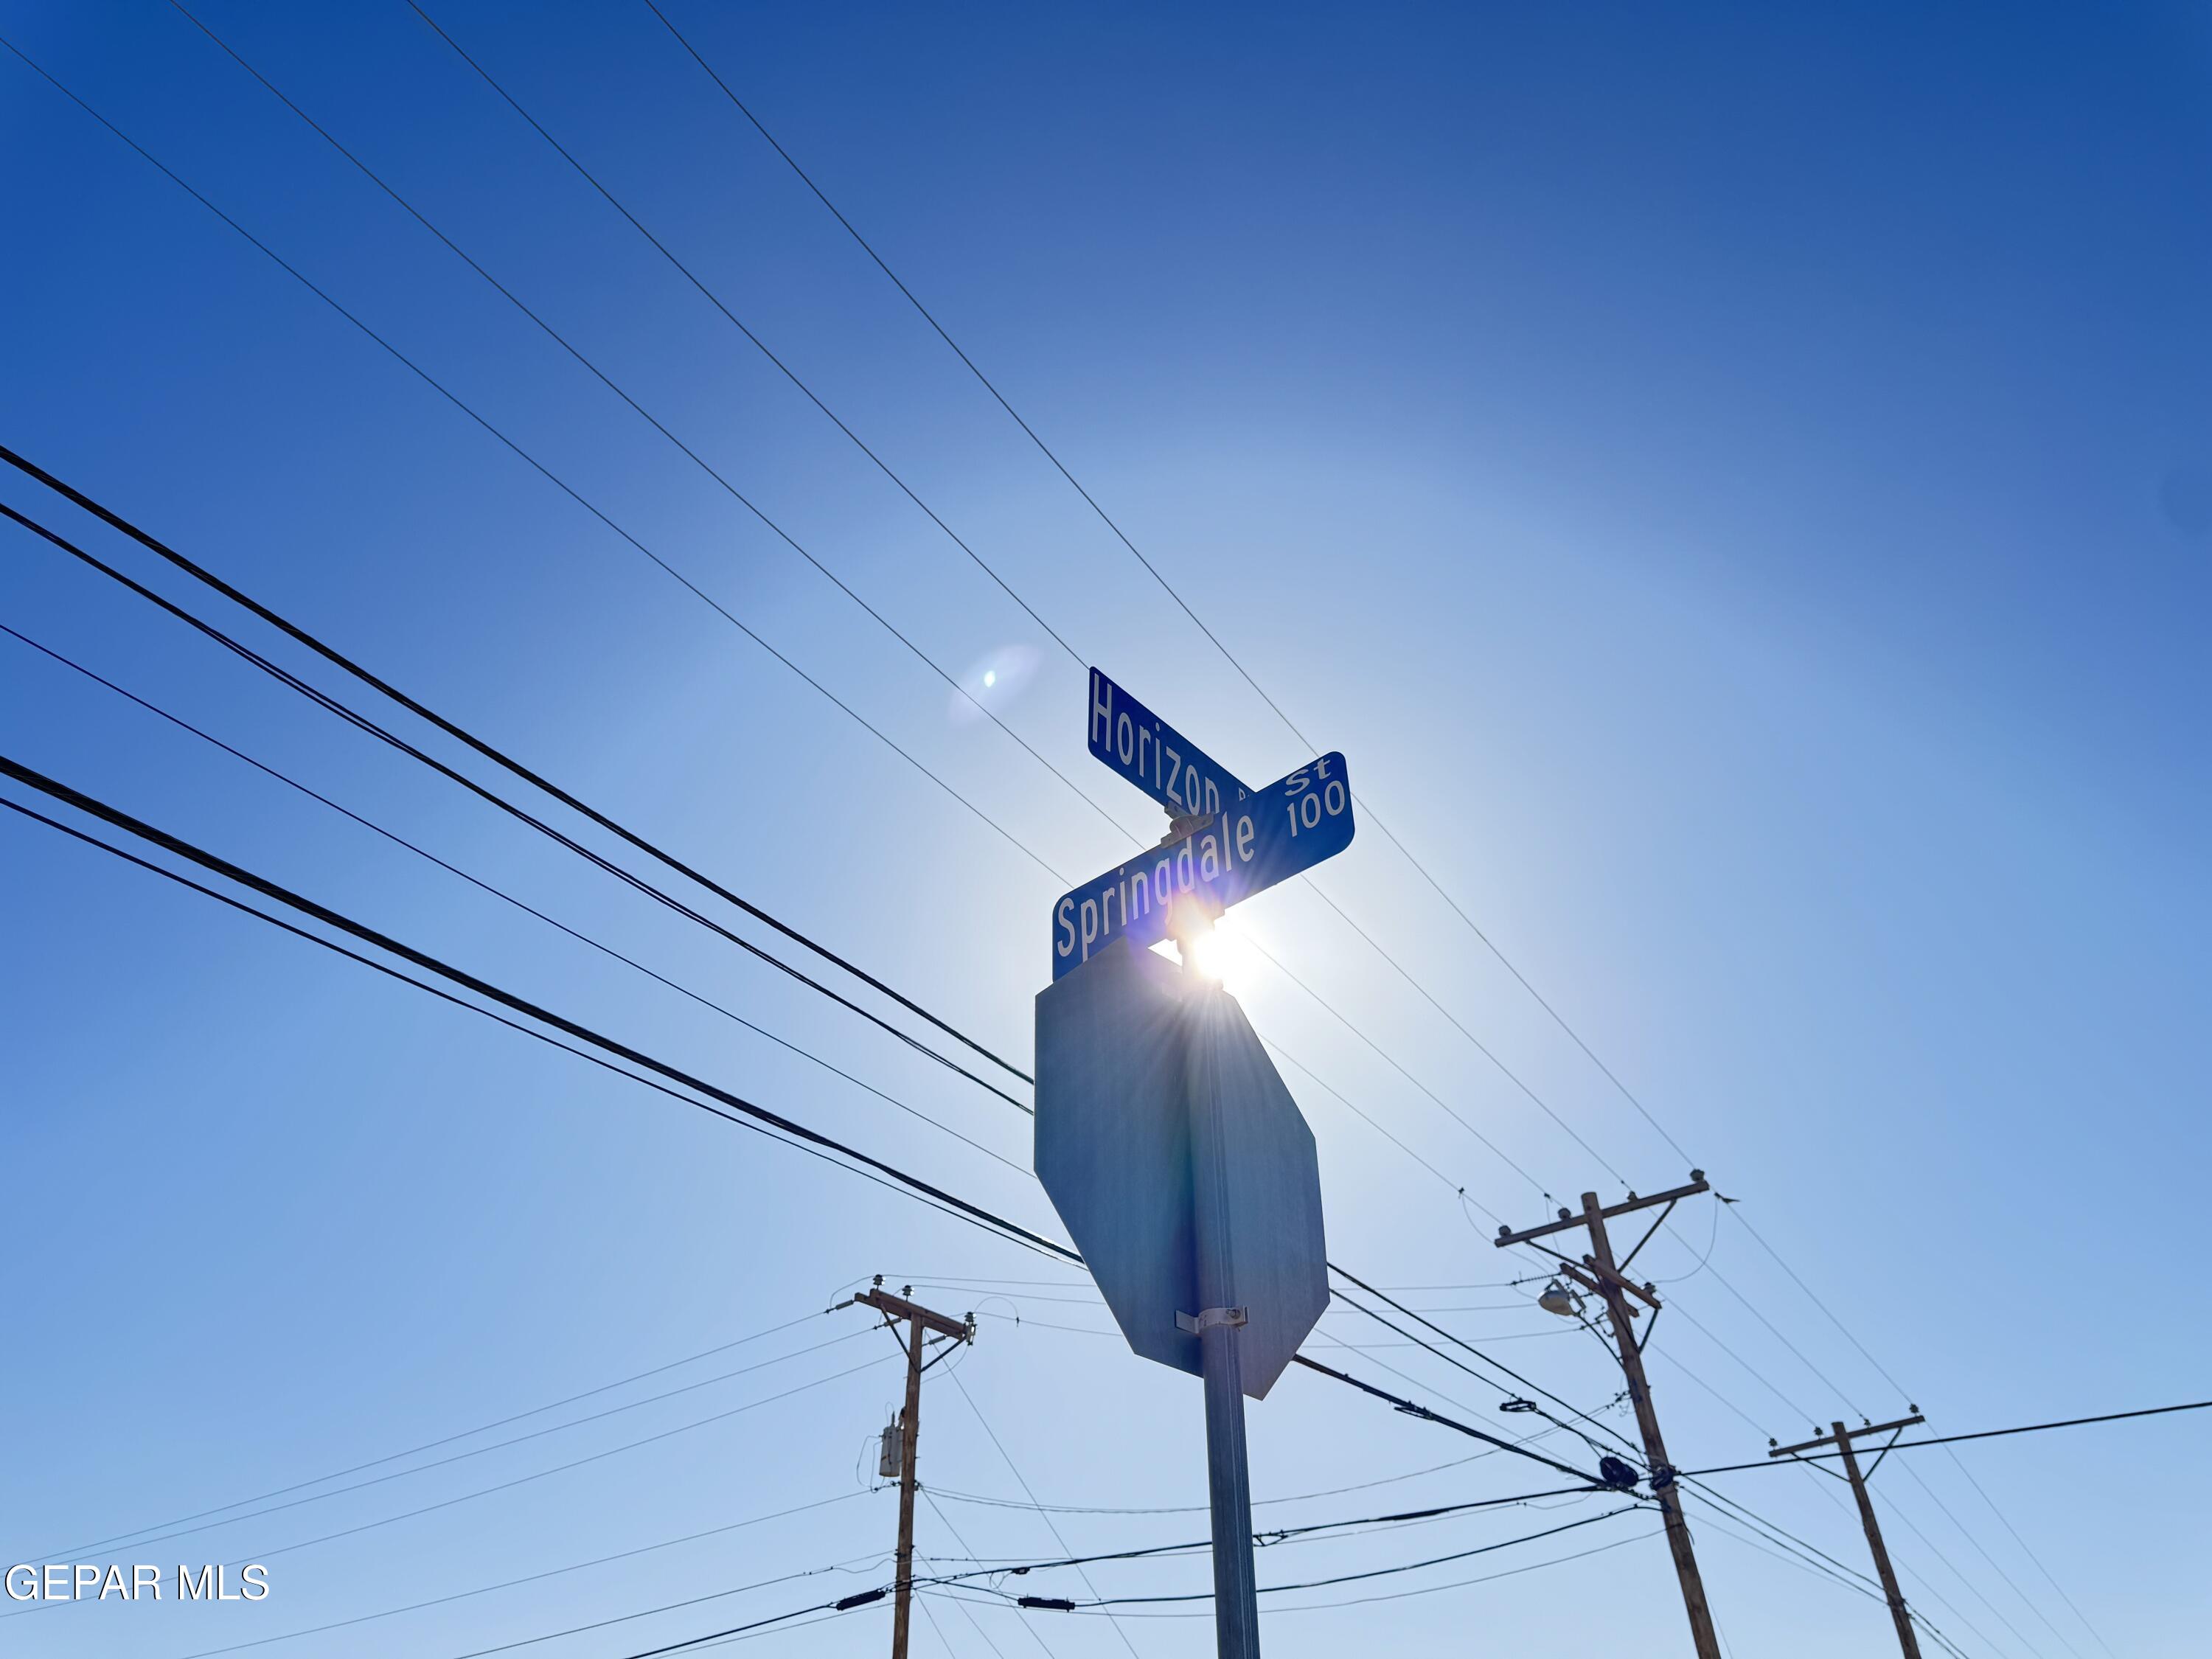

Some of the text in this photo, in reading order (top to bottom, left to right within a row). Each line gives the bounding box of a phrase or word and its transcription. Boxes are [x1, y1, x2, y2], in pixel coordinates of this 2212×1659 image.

[1092, 673, 1220, 816] Horizon
[1284, 758, 1332, 796] St
[1287, 780, 1346, 838] 100
[1057, 811, 1254, 962] Springdale
